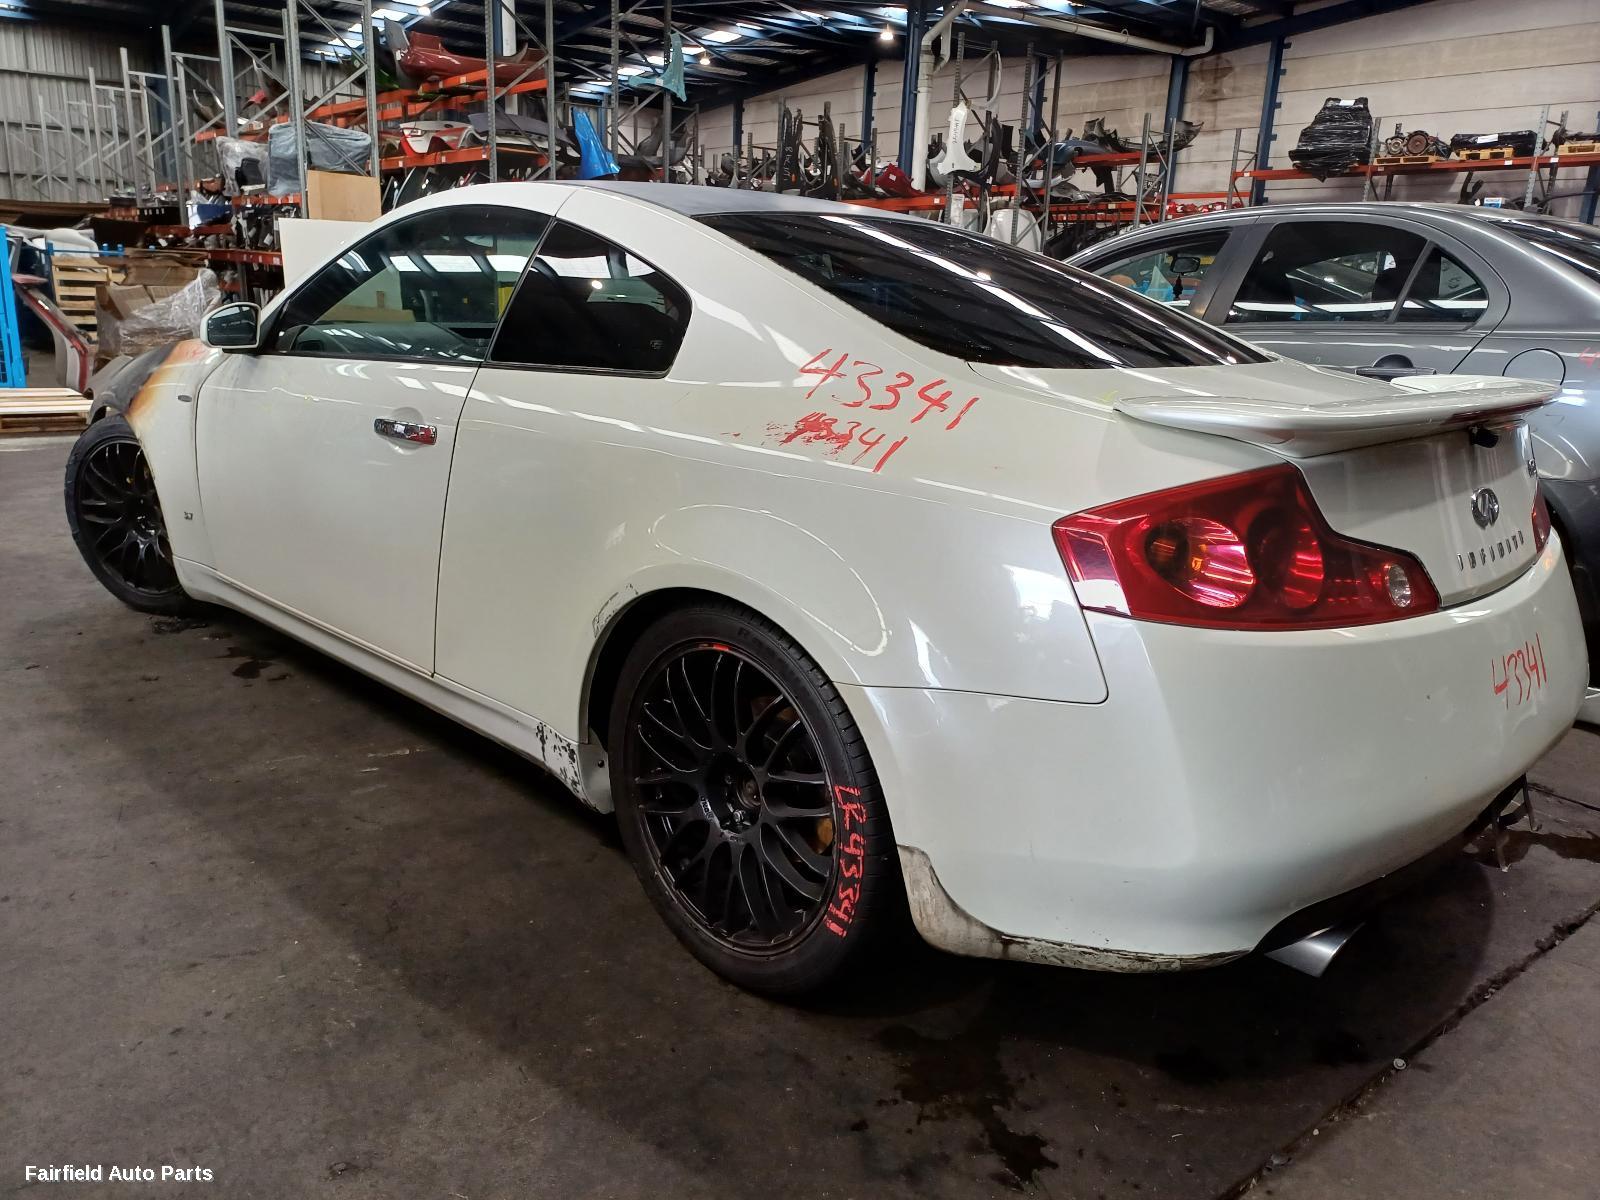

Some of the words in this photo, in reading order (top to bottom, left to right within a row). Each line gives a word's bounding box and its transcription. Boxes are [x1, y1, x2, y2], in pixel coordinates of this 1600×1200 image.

[799, 348, 980, 431] 43341
[1457, 530, 1525, 572] INFINITI
[1491, 632, 1548, 710] 43341
